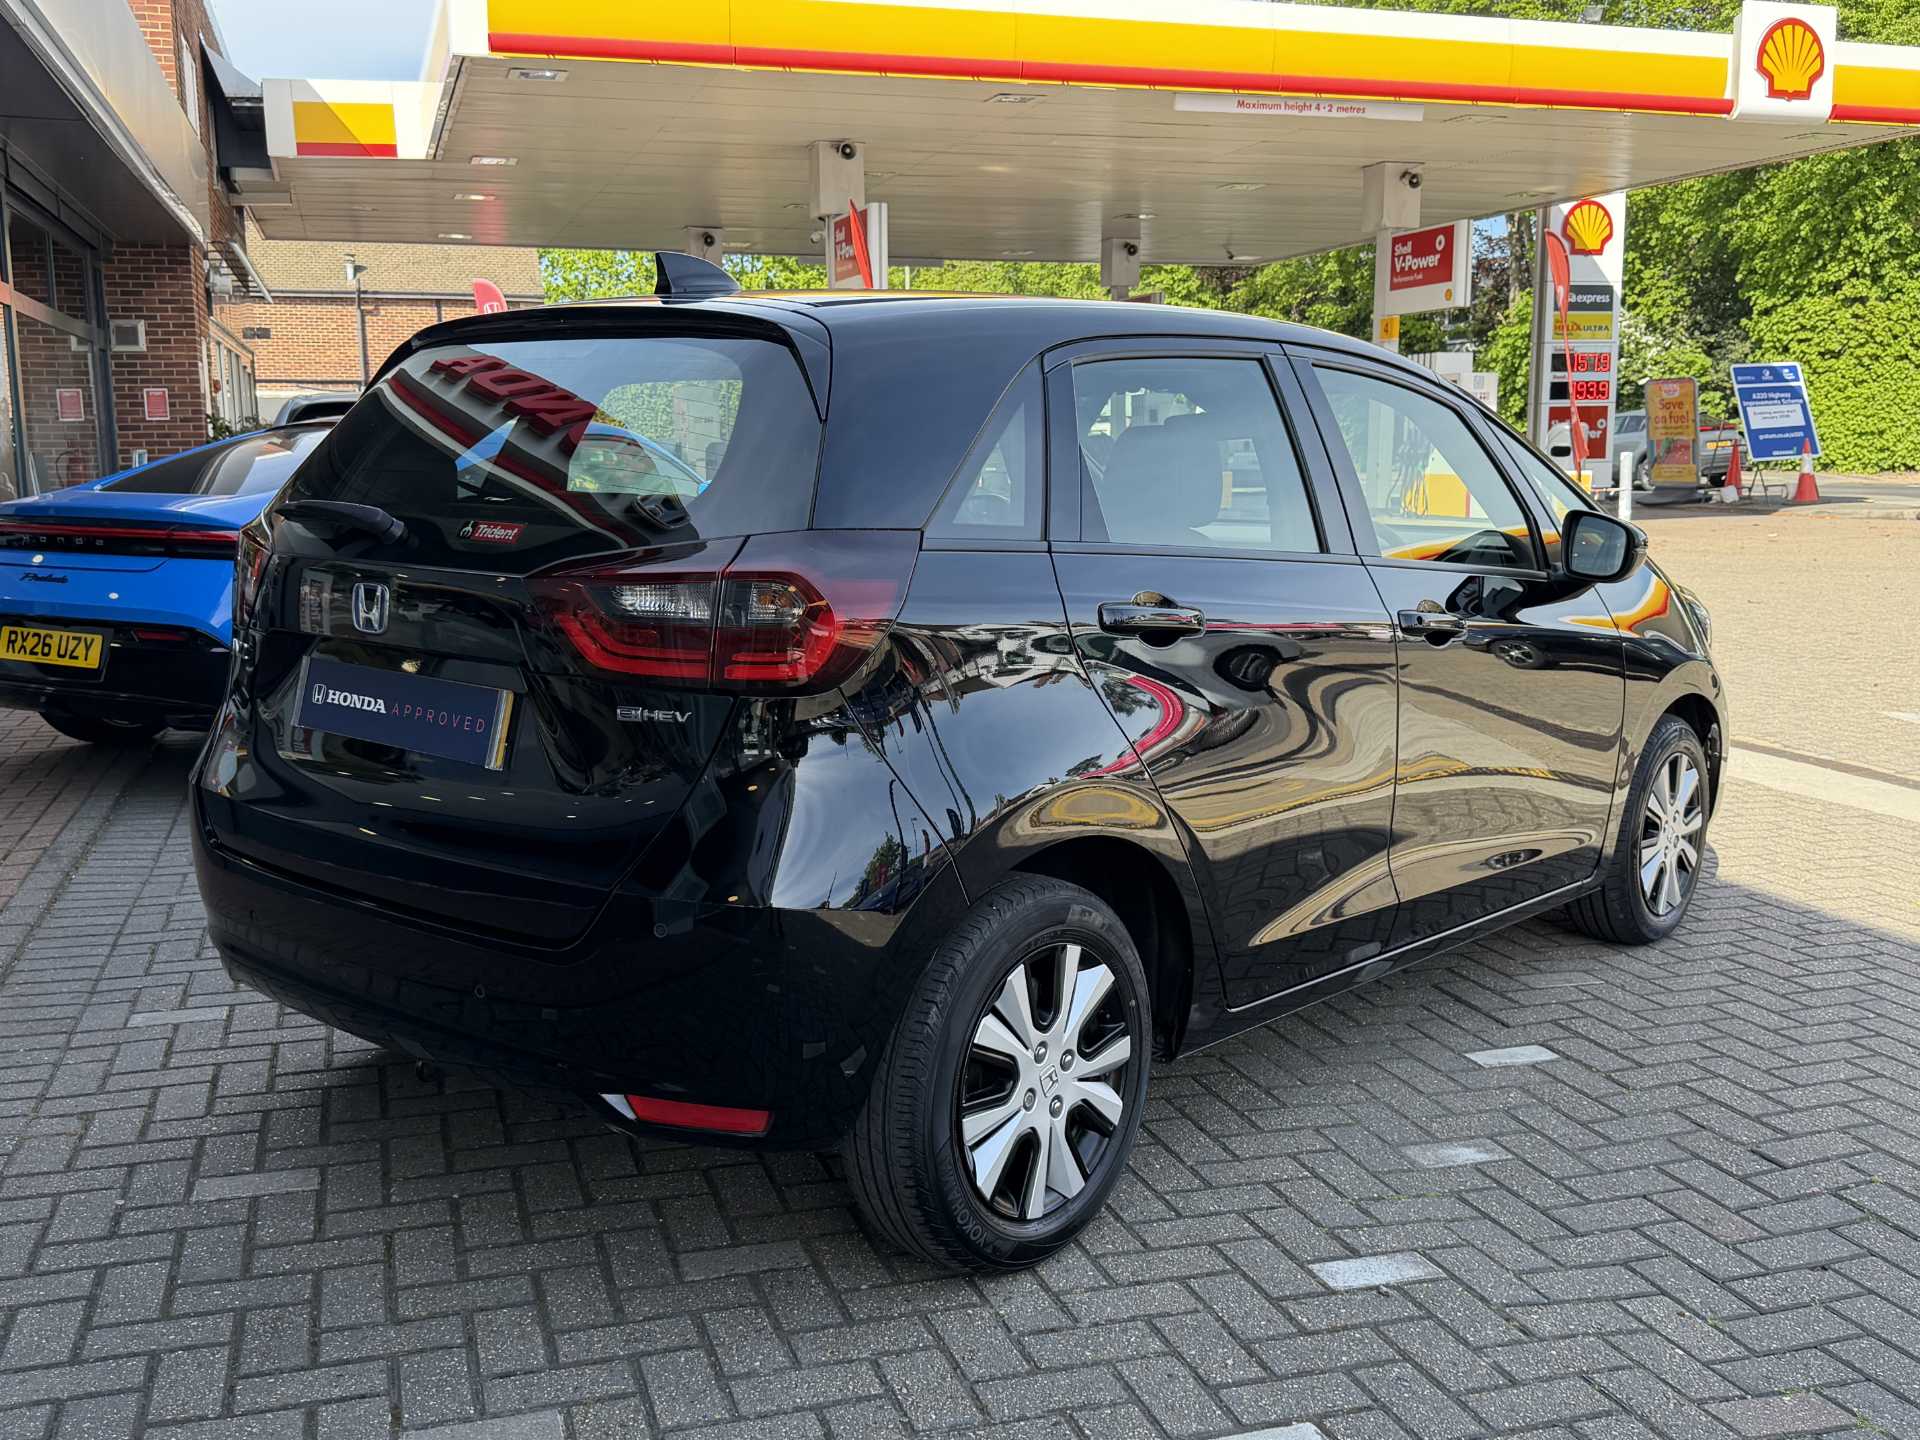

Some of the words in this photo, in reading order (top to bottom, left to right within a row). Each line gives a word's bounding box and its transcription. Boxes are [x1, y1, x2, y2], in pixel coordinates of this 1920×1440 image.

[1236, 99, 1281, 112] Maximum
[1284, 101, 1312, 113] height
[1336, 105, 1366, 115] metres
[1394, 240, 1412, 256] Shell
[1577, 293, 1610, 304] express
[1383, 322, 1389, 336] 4
[1583, 324, 1609, 332] ULTRA
[1574, 352, 1610, 372] 157.9
[1573, 381, 1609, 400] 193.9
[1658, 399, 1684, 410] Save
[1655, 414, 1667, 424] on
[1668, 411, 1689, 425] fuel
[475, 524, 519, 540] Trident
[6, 630, 52, 657] RX26
[57, 635, 95, 661] UZY
[327, 689, 387, 714] HONDA
[391, 703, 487, 734] APPROVED
